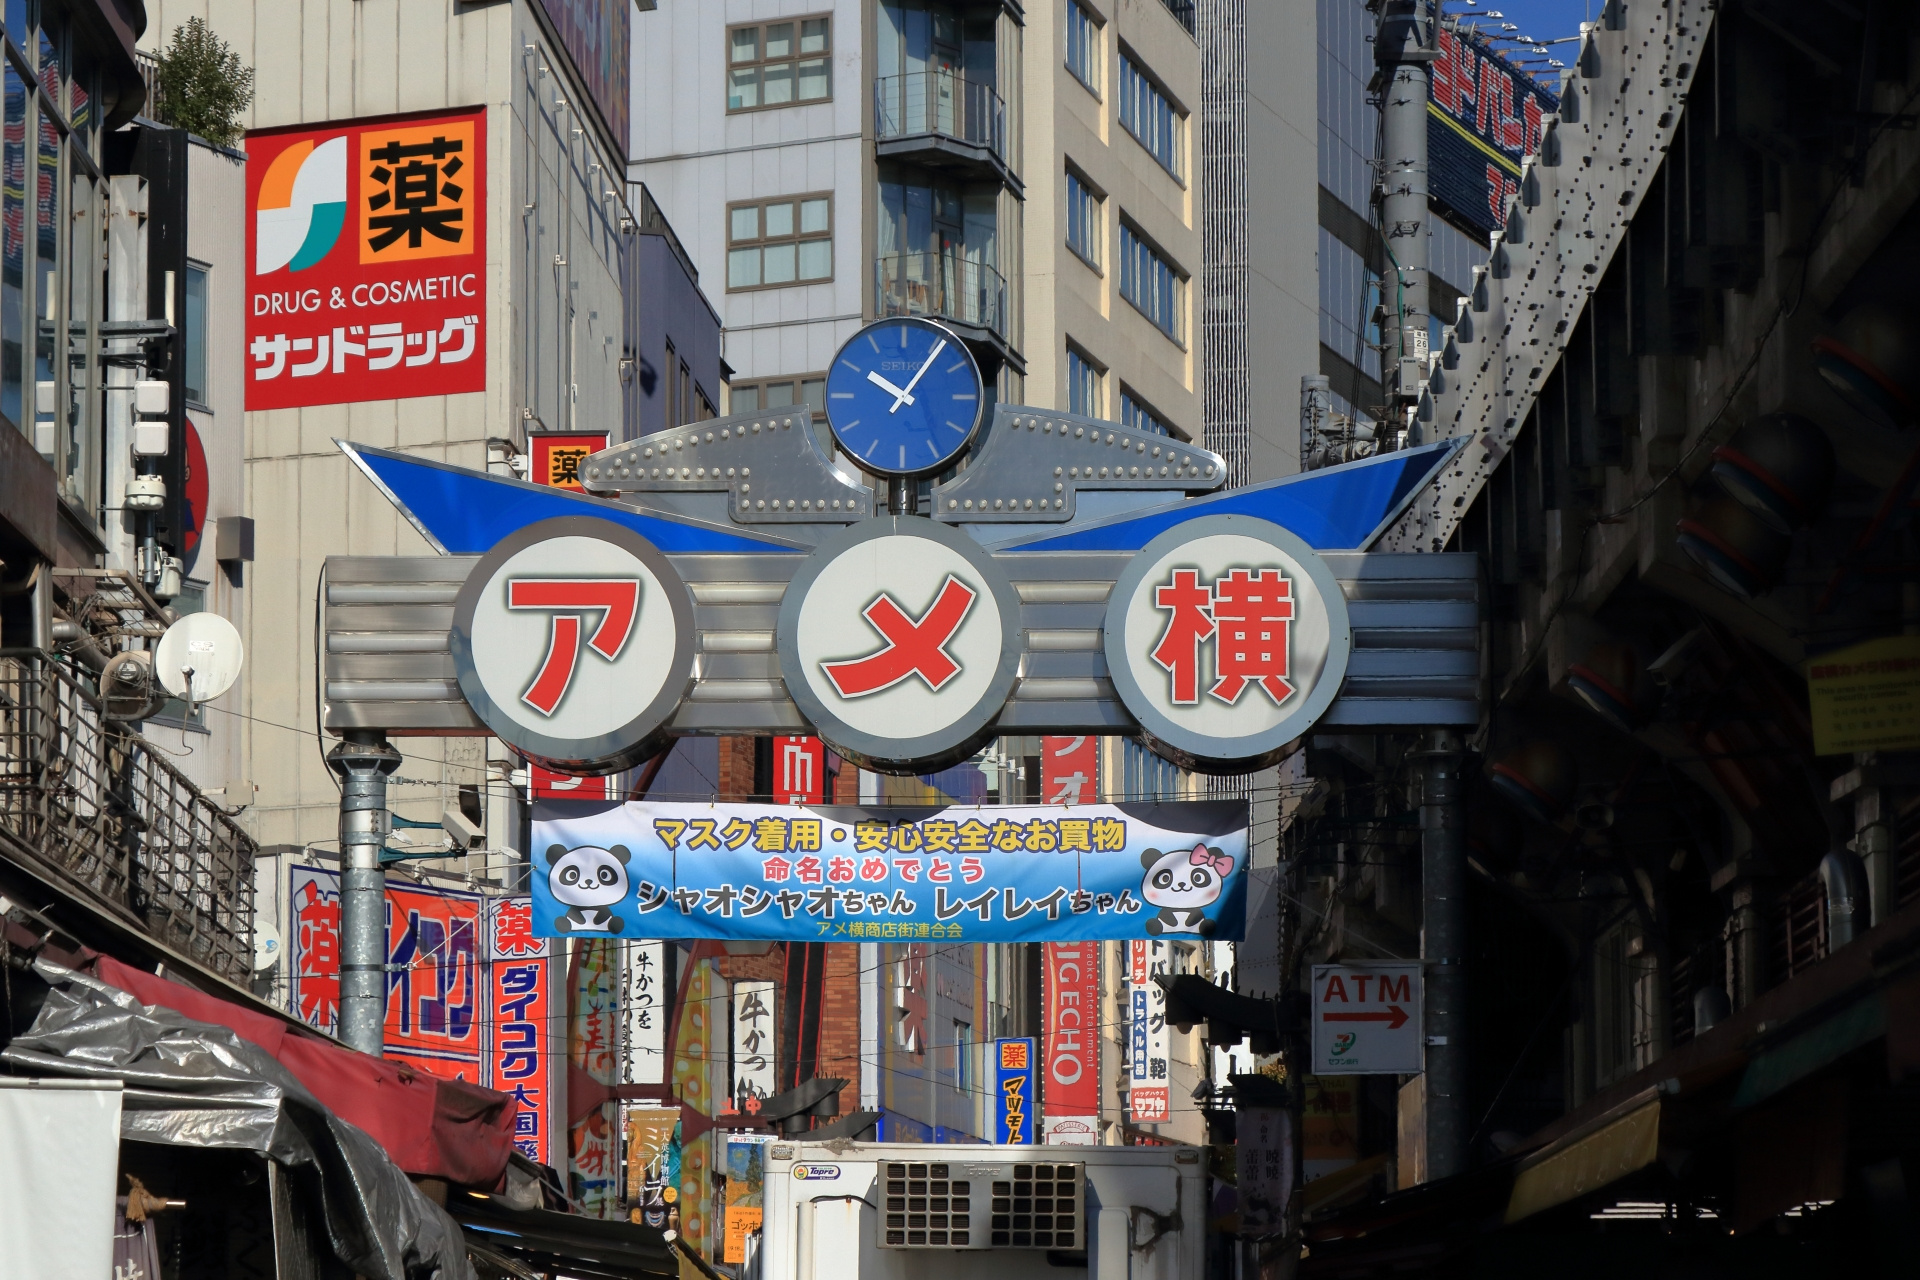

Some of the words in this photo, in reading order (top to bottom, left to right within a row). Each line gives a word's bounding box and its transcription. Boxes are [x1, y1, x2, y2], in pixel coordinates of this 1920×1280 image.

[368, 136, 463, 253] 薬
[254, 289, 321, 316] DRUG
[329, 287, 347, 309] &
[351, 273, 476, 308] COSMETIC
[250, 314, 480, 381] サンドラッグ
[552, 449, 587, 484] 薬
[653, 816, 1128, 854] マスク着用・安心安全なお買物
[762, 855, 986, 885] 命名おめでとう
[636, 880, 917, 920] シャオシャオちゃん
[933, 886, 1143, 923] レイレイちゃん
[495, 899, 545, 956] 薬
[816, 920, 964, 939] アメ横商店街連合会
[384, 902, 475, 1041] イコク
[636, 951, 654, 1030] 牛かつを
[1323, 974, 1411, 1003] ATM
[1052, 991, 1083, 1086] ECHO
[1086, 985, 1096, 1068] Entertainment
[1003, 1043, 1027, 1068] 薬
[1328, 1058, 1359, 1066] セブン銀行
[1322, 1079, 1346, 1089] THAI
[1133, 1097, 1166, 1118] マスヤ
[660, 1131, 670, 1187] 大英博物館
[810, 1167, 835, 1176] Topre
[731, 1218, 763, 1231] ゴッホ
